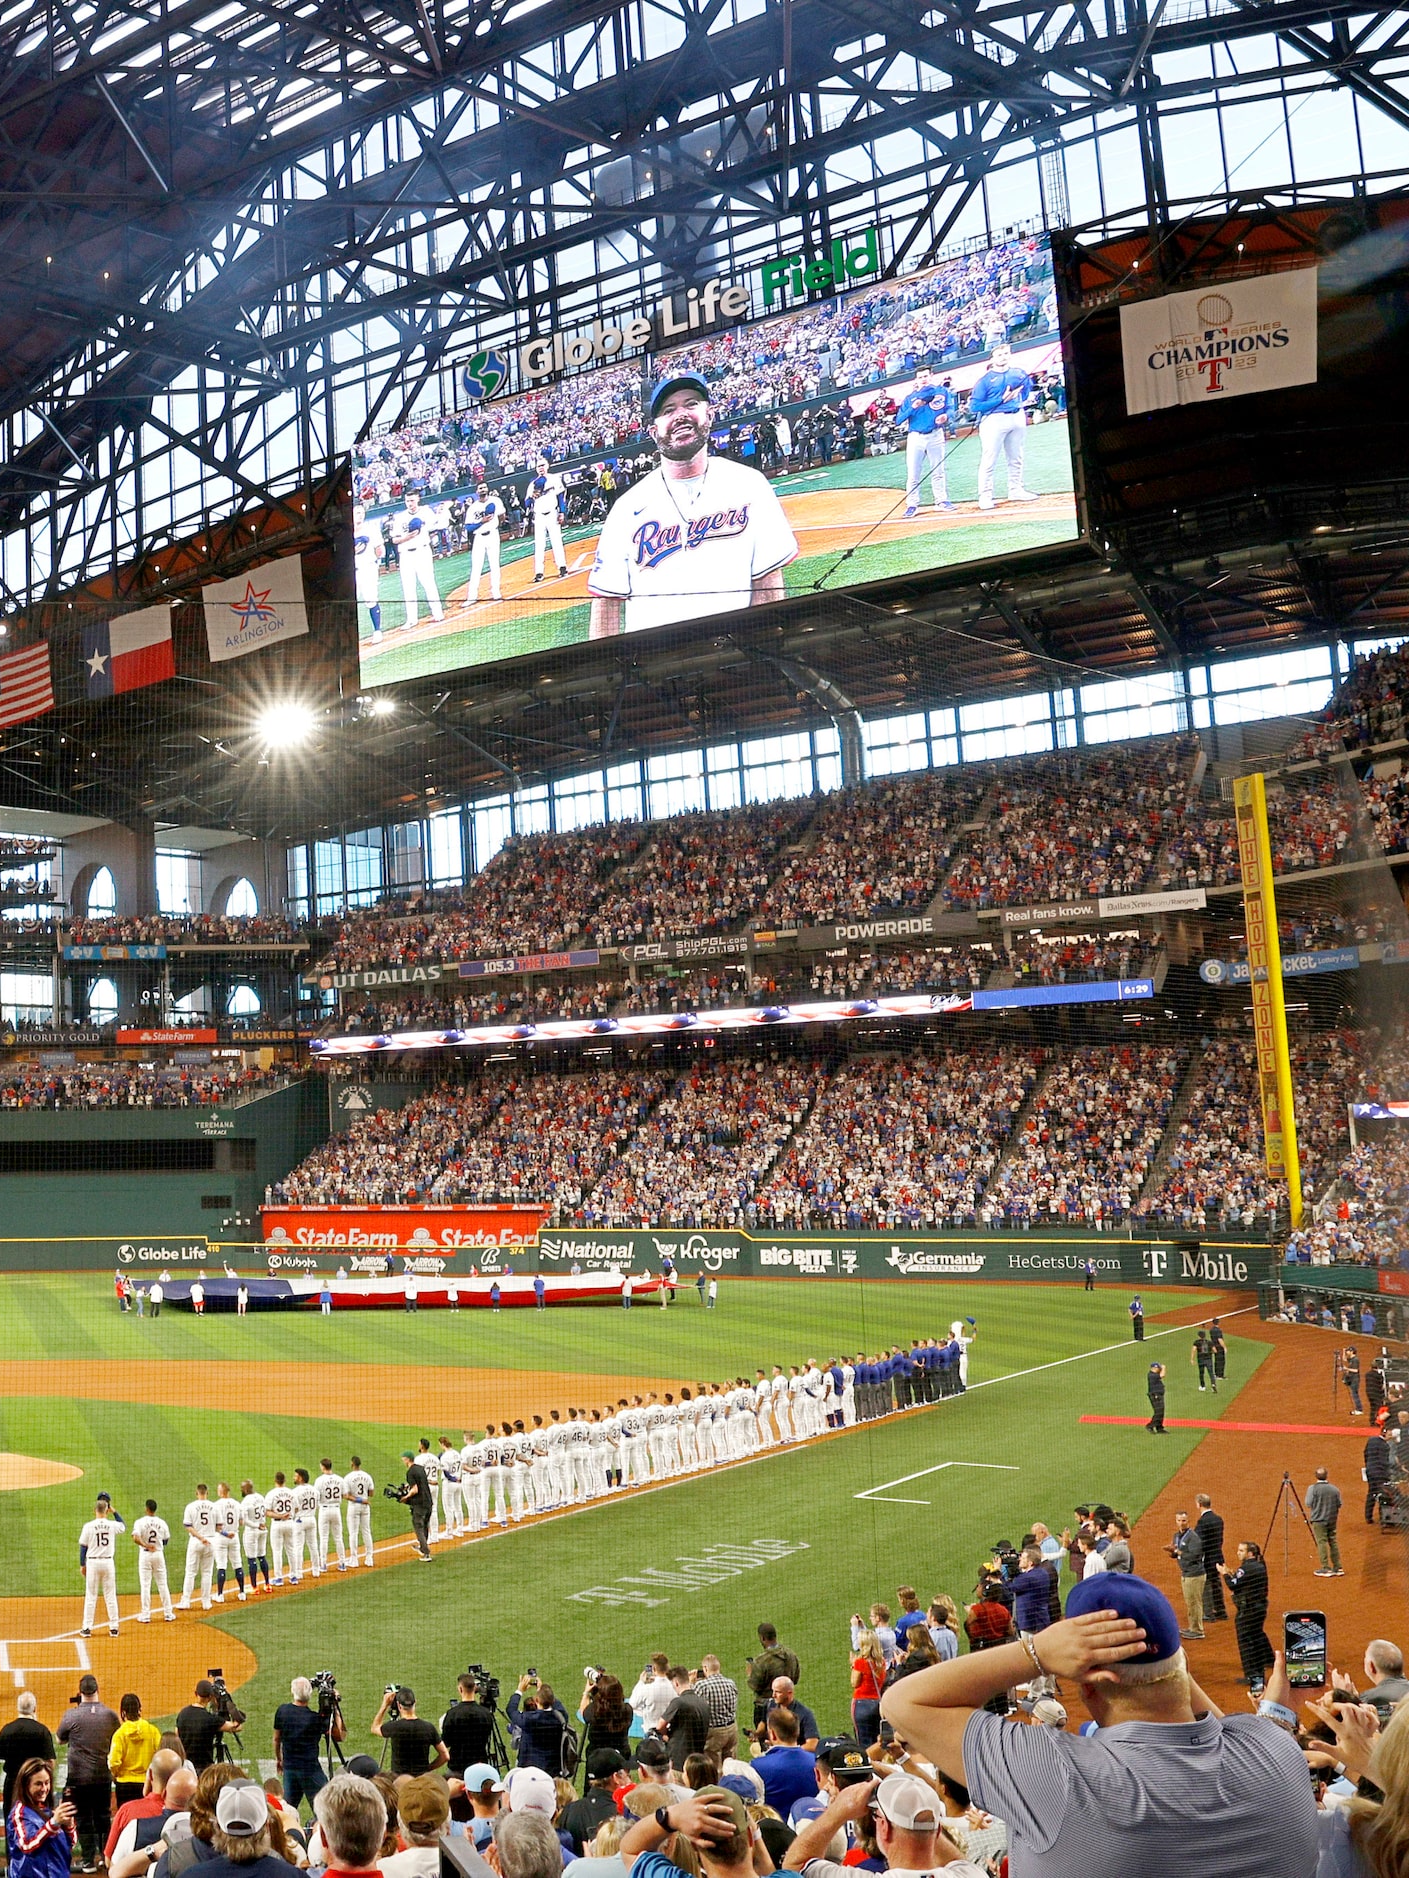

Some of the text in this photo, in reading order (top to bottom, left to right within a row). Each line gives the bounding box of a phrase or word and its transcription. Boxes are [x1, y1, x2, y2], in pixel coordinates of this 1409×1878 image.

[520, 228, 880, 379] Globe Life Field
[1154, 321, 1282, 351] WORLD SERIES
[1148, 328, 1290, 370] CHAMPIONS
[633, 503, 751, 568] Rangers
[225, 617, 285, 648] ARLINGTON
[1243, 821, 1255, 883] THE
[1005, 905, 1094, 922] Real fans know.
[835, 918, 933, 940] POWERADE
[1250, 906, 1262, 964] HOT
[675, 936, 748, 950] ShipPGL.com
[634, 943, 669, 957] PGL
[676, 943, 748, 957] 877.701.1919
[483, 952, 572, 975] 105.3 THE FAN
[333, 964, 441, 989] UT DALLAS
[1124, 984, 1148, 994] 6:29
[1257, 985, 1271, 1069] ZONE
[16, 1032, 100, 1042] PRIORITY GOLD
[232, 1030, 295, 1041] PLUCKERS
[195, 1120, 234, 1129] TEREMANA
[138, 1246, 207, 1261] Globe Life
[207, 1245, 220, 1253] 410
[509, 1247, 525, 1255] 374
[283, 1256, 318, 1268] Kubota
[793, 1248, 835, 1265] BITE
[913, 1250, 984, 1267] Germania
[482, 1265, 501, 1273] SPORTS
[586, 1259, 601, 1269] Car
[799, 1265, 826, 1273] PIZZA
[654, 1414, 664, 1425] 30
[572, 1432, 583, 1442] 46
[505, 1448, 516, 1460] 57
[521, 1442, 531, 1454] 54
[325, 1486, 340, 1499] 32
[357, 1483, 364, 1495] 3
[277, 1499, 291, 1512] 36
[302, 1497, 315, 1510] 20
[200, 1512, 208, 1525] 5
[226, 1512, 234, 1525] 6
[95, 1532, 109, 1546] 15
[148, 1530, 157, 1543] 2
